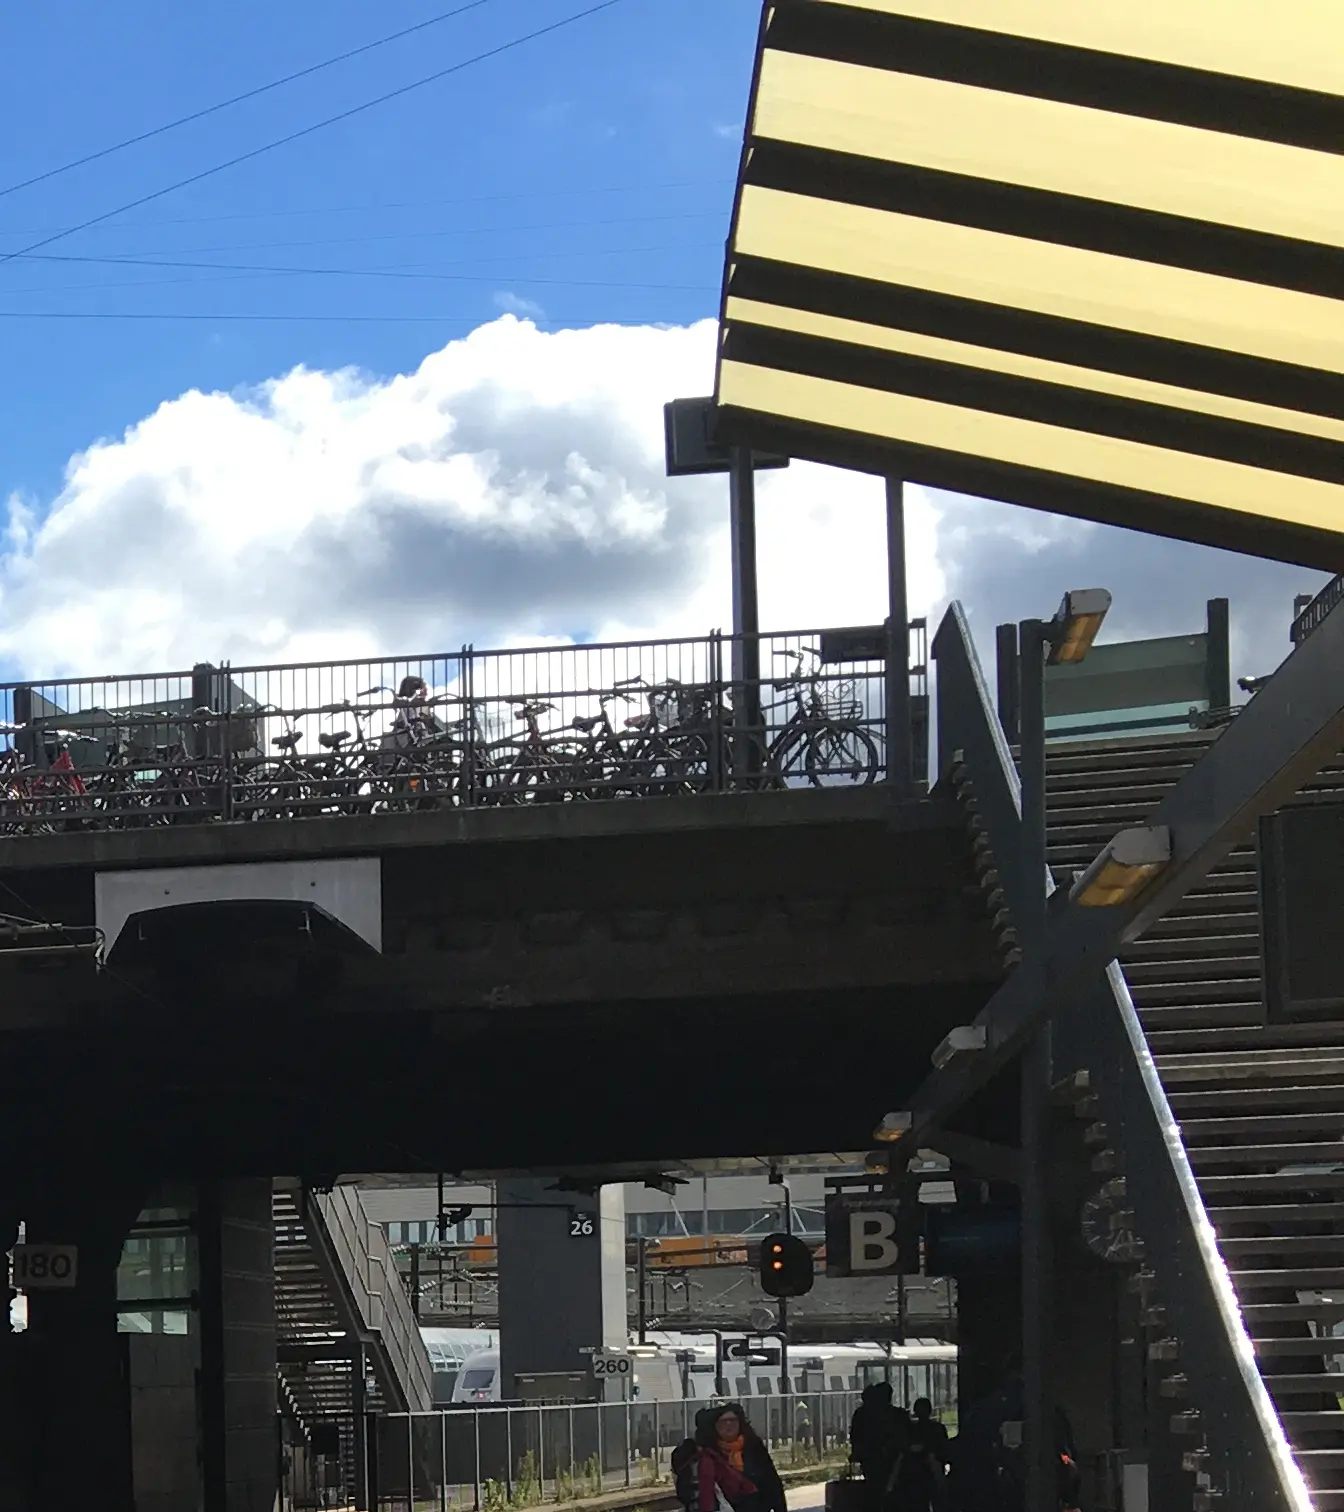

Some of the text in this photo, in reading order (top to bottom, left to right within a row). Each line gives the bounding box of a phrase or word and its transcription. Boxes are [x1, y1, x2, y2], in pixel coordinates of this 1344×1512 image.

[570, 1220, 594, 1236] 26
[848, 1211, 899, 1271] B
[18, 1251, 72, 1280] 180
[595, 1359, 629, 1375] 260
